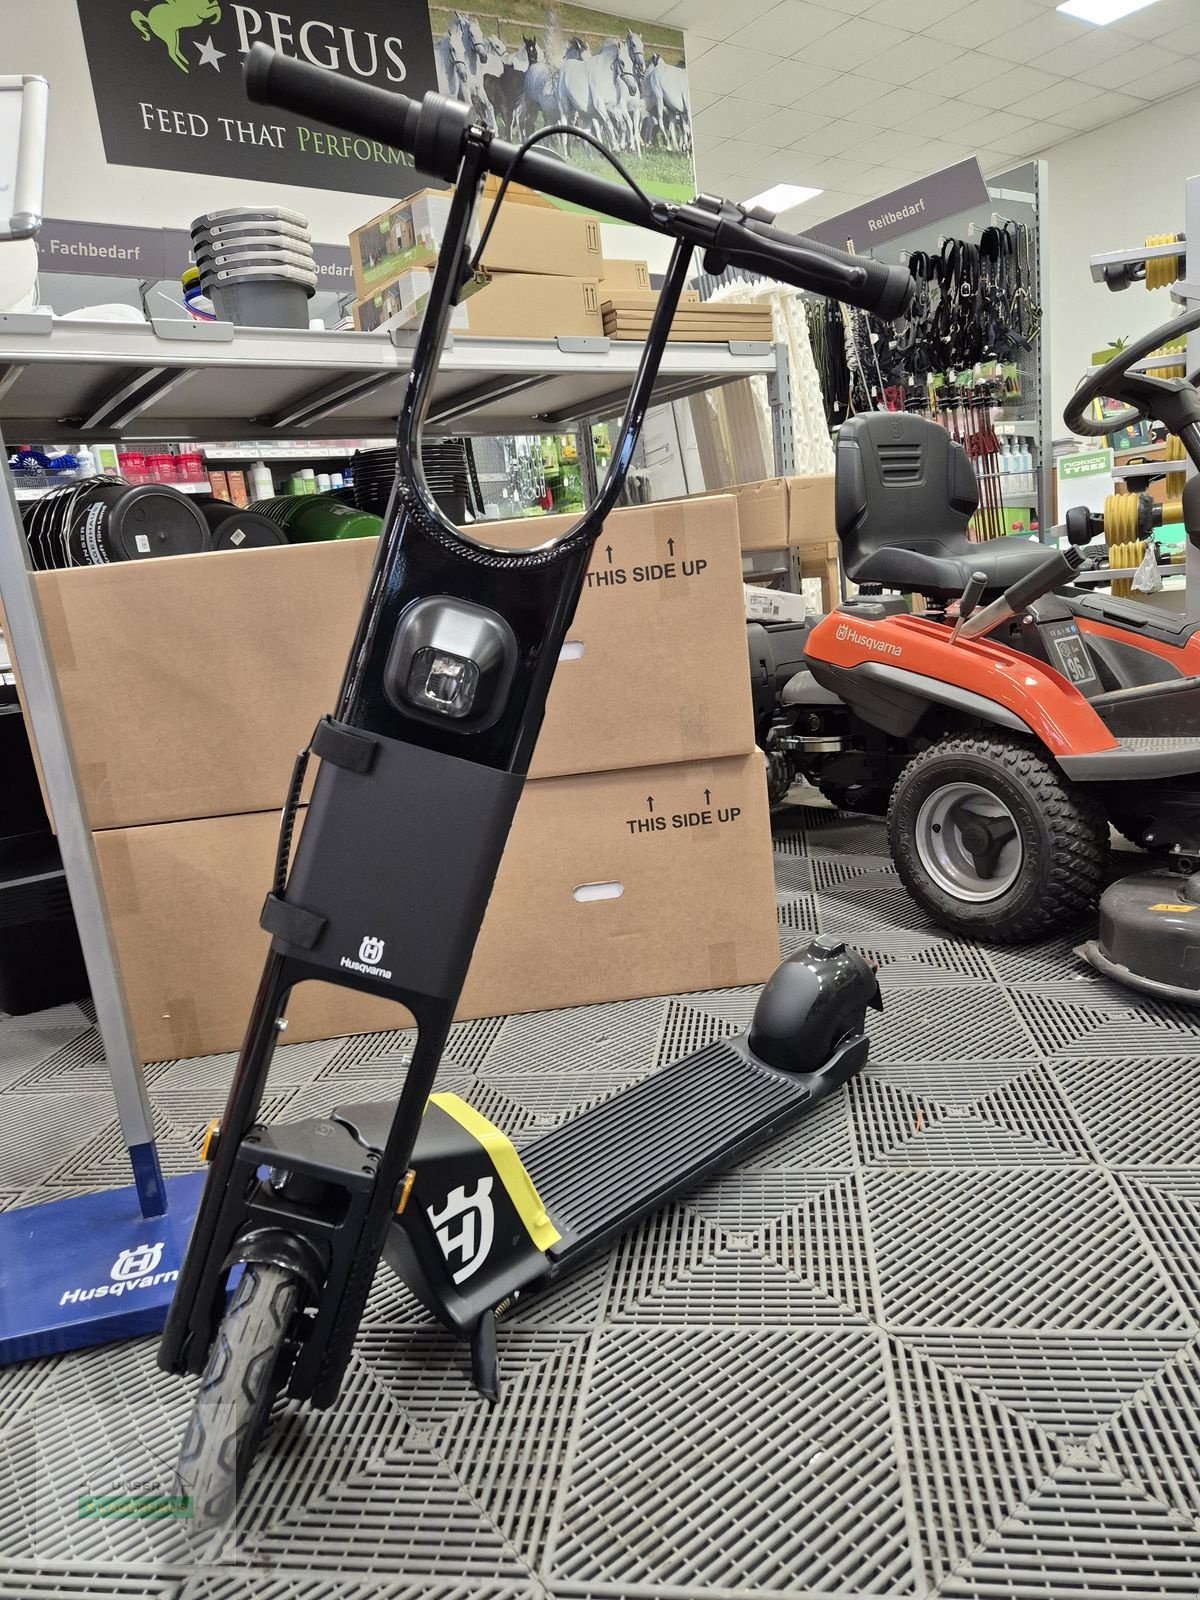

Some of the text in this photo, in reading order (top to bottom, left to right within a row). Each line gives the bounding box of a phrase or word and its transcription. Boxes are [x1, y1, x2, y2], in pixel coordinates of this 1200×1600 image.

[230, 3, 407, 82] PEGUS
[868, 198, 926, 232] Reitbedarf
[50, 239, 140, 260] Fachbedarf
[313, 263, 354, 277] bedarf
[1063, 462, 1107, 475] TYRES
[80, 526, 93, 566] UNSER
[87, 506, 101, 565] AGERHAUS
[586, 559, 708, 588] THIS SIDE UP
[846, 628, 903, 657] Husqvarna
[1067, 656, 1086, 681] 96
[626, 807, 741, 834] THIS SIDE UP
[340, 955, 393, 979] Husqvarna
[59, 1269, 179, 1306] Husqvarn
